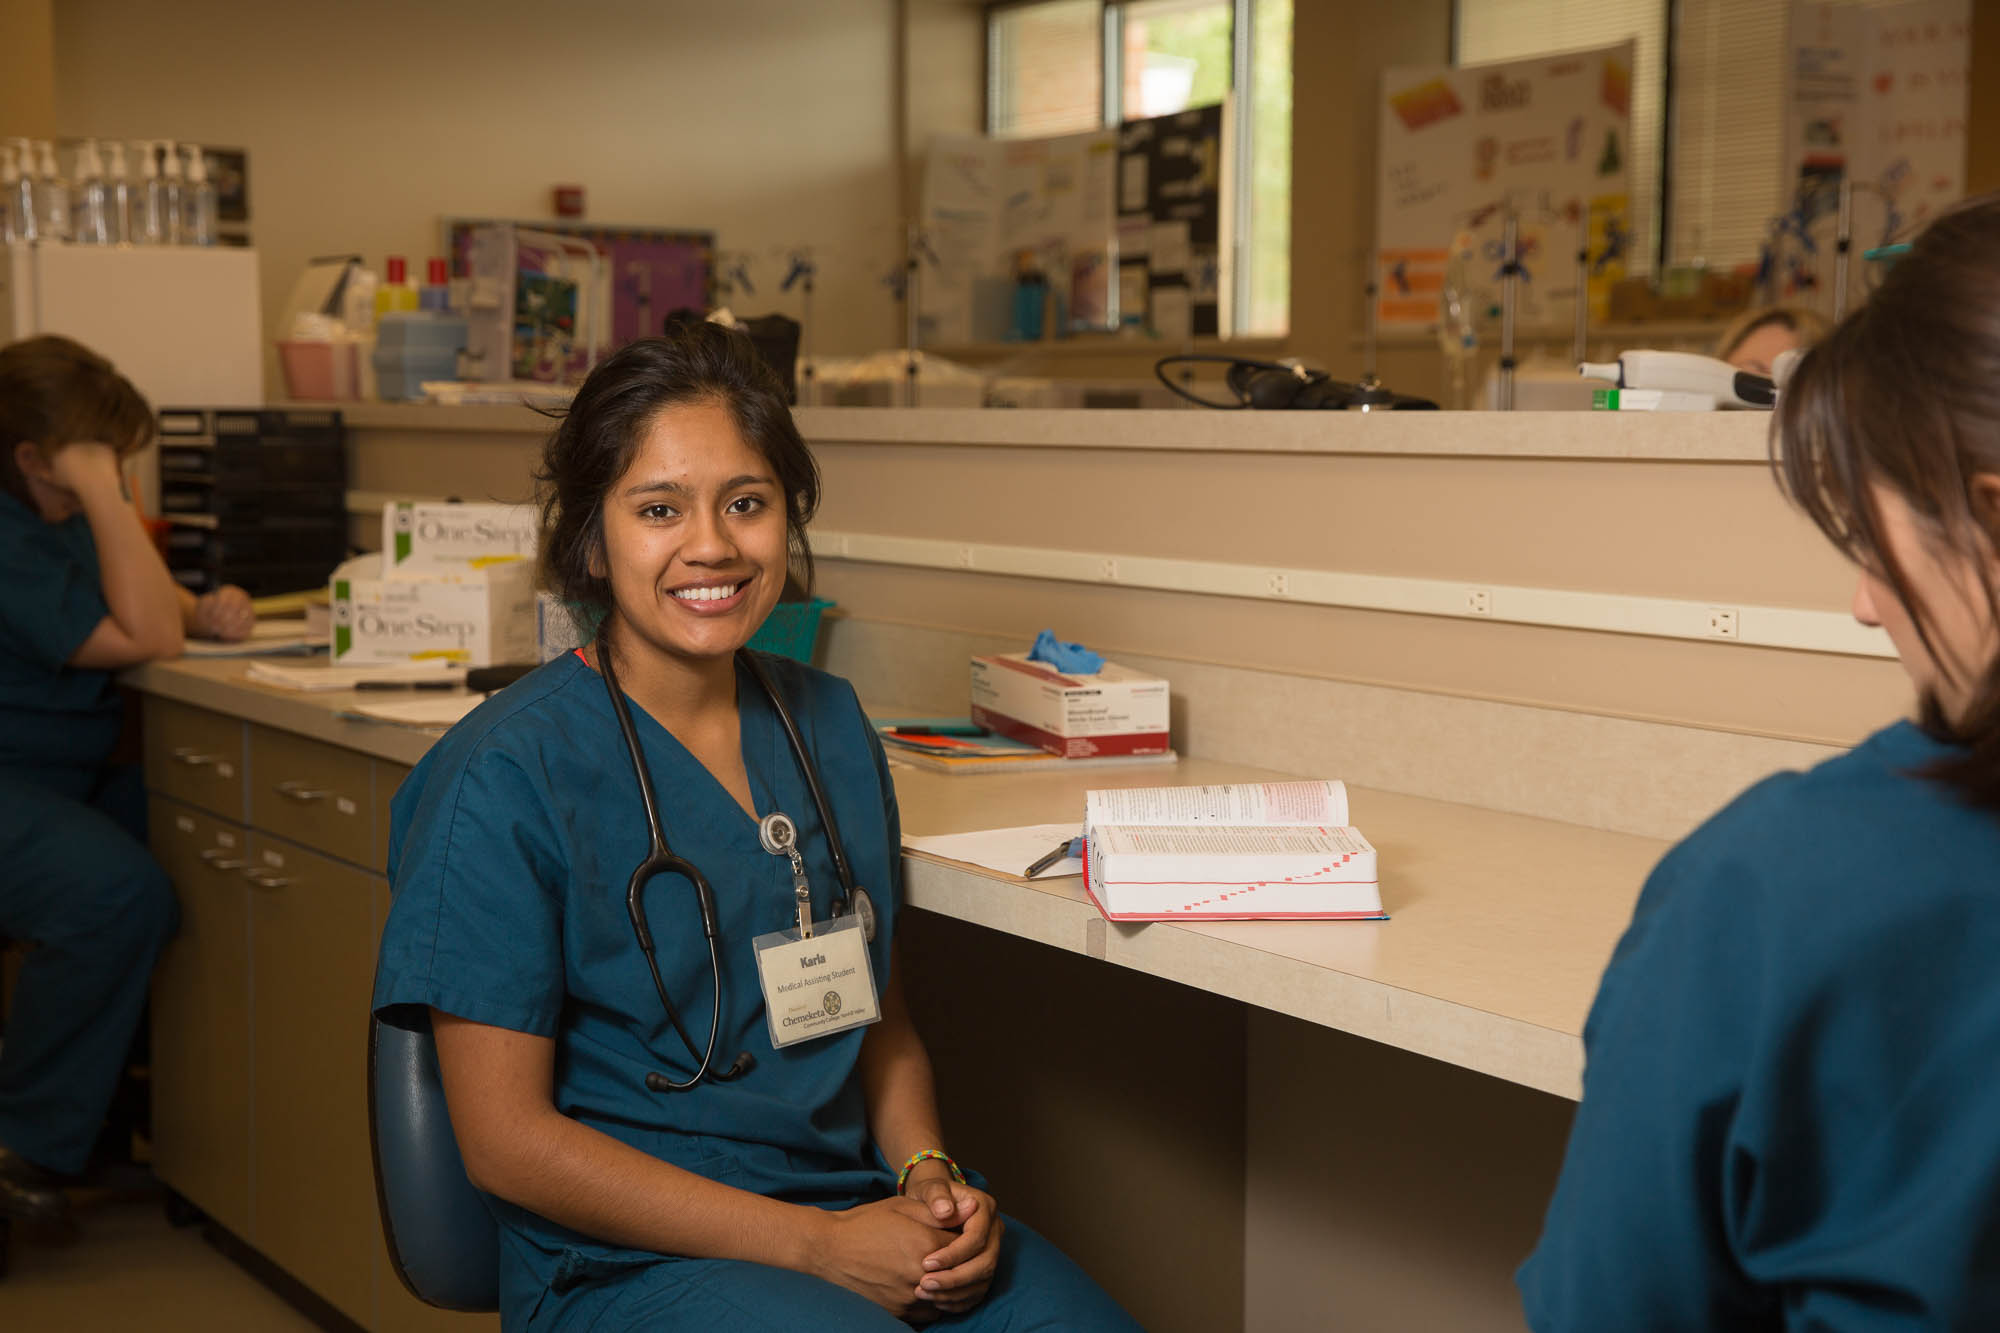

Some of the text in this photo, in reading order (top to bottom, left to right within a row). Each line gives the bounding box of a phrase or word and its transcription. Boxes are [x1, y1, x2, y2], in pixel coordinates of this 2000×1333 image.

[800, 954, 826, 968] Karla
[777, 967, 856, 993] Medical Assisting Student
[783, 1009, 825, 1026] Chemeketa
